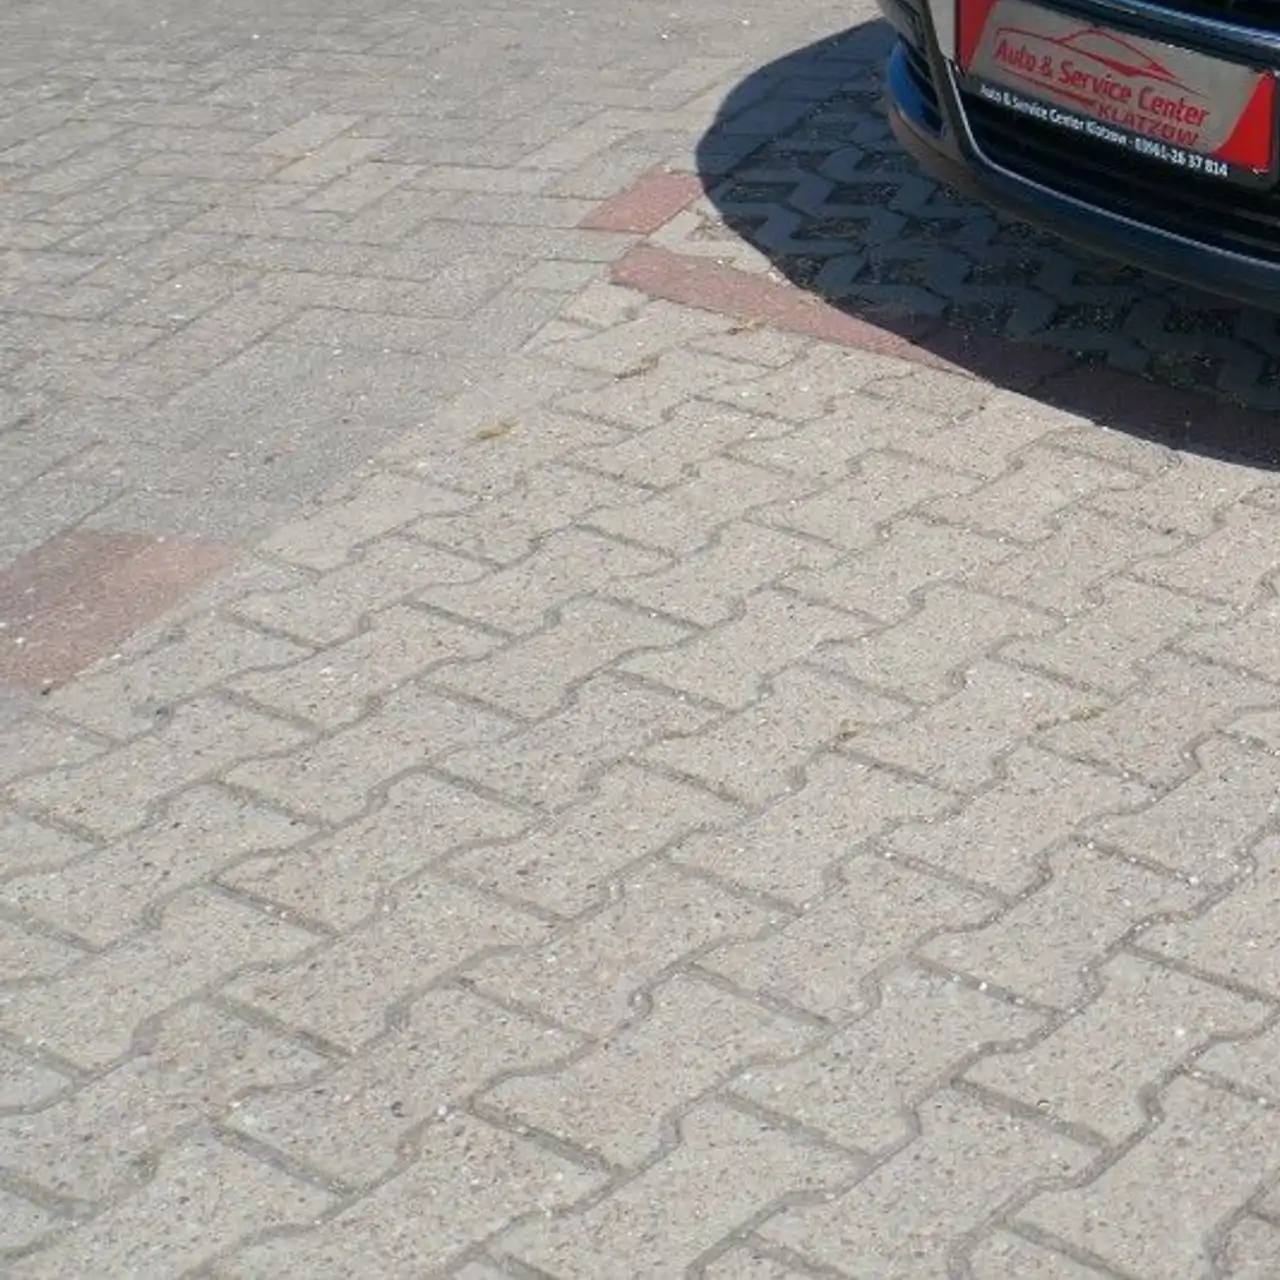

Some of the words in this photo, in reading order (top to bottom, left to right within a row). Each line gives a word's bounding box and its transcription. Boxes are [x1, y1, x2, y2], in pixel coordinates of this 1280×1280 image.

[994, 38, 1036, 72] Auto
[1038, 55, 1053, 78] &
[1058, 61, 1132, 101] Service
[1138, 85, 1210, 127] Center
[1097, 101, 1199, 147] KLATZOW
